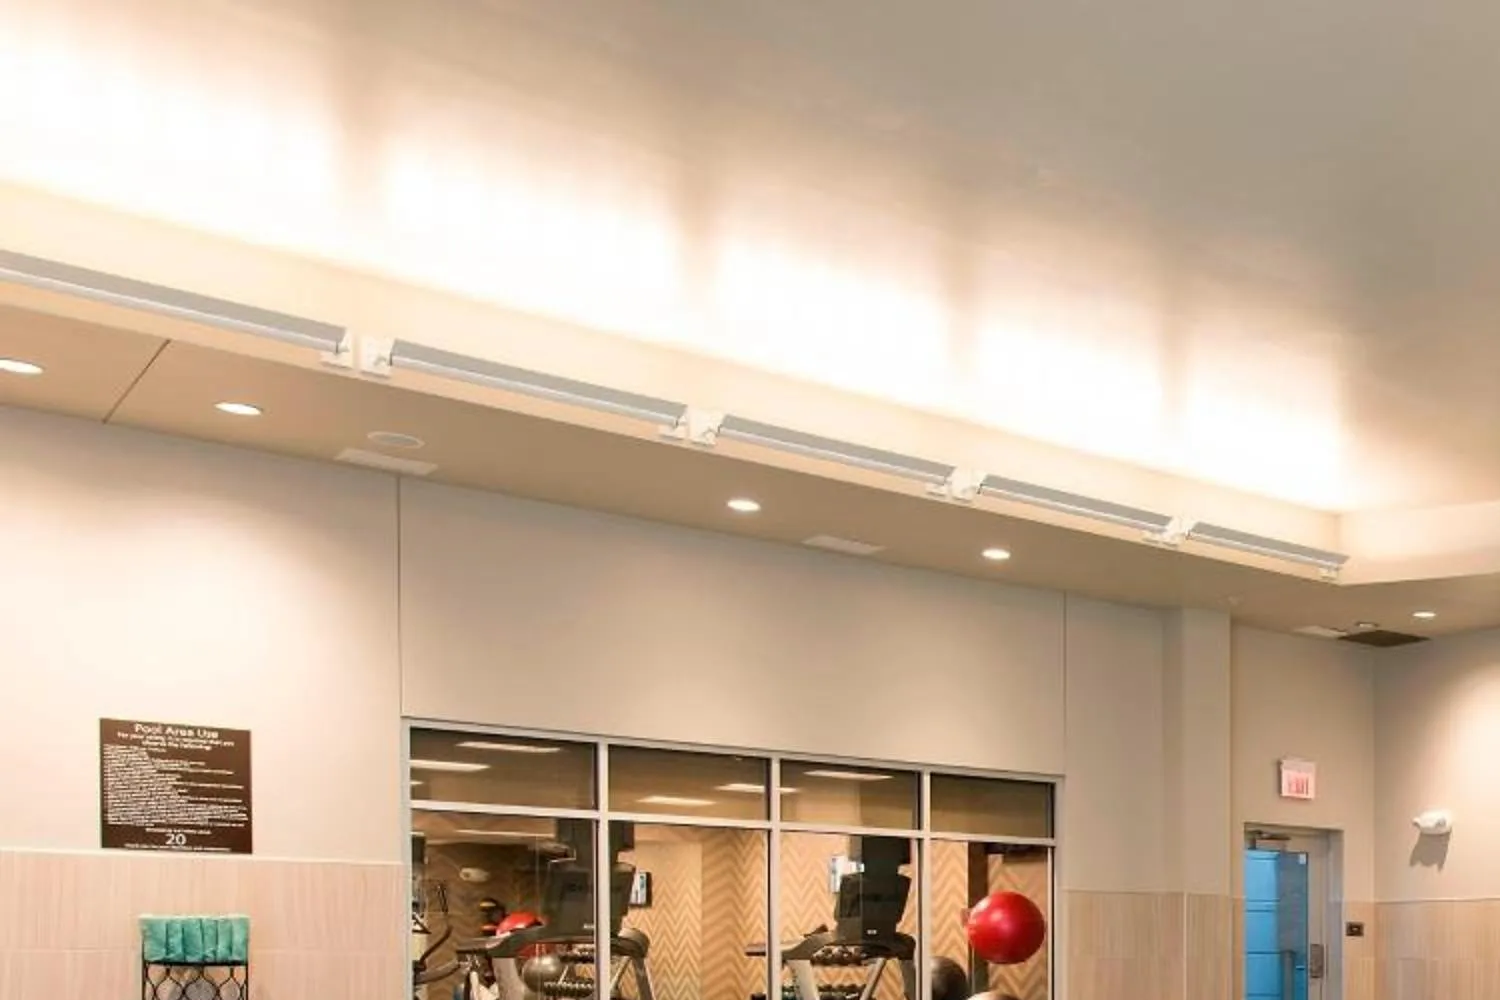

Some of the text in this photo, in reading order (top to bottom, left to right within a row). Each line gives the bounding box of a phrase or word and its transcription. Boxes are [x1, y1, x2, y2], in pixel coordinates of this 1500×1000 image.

[134, 723, 162, 735] Pool
[165, 726, 195, 741] Area
[197, 729, 219, 744] Use
[165, 833, 187, 845] 20
